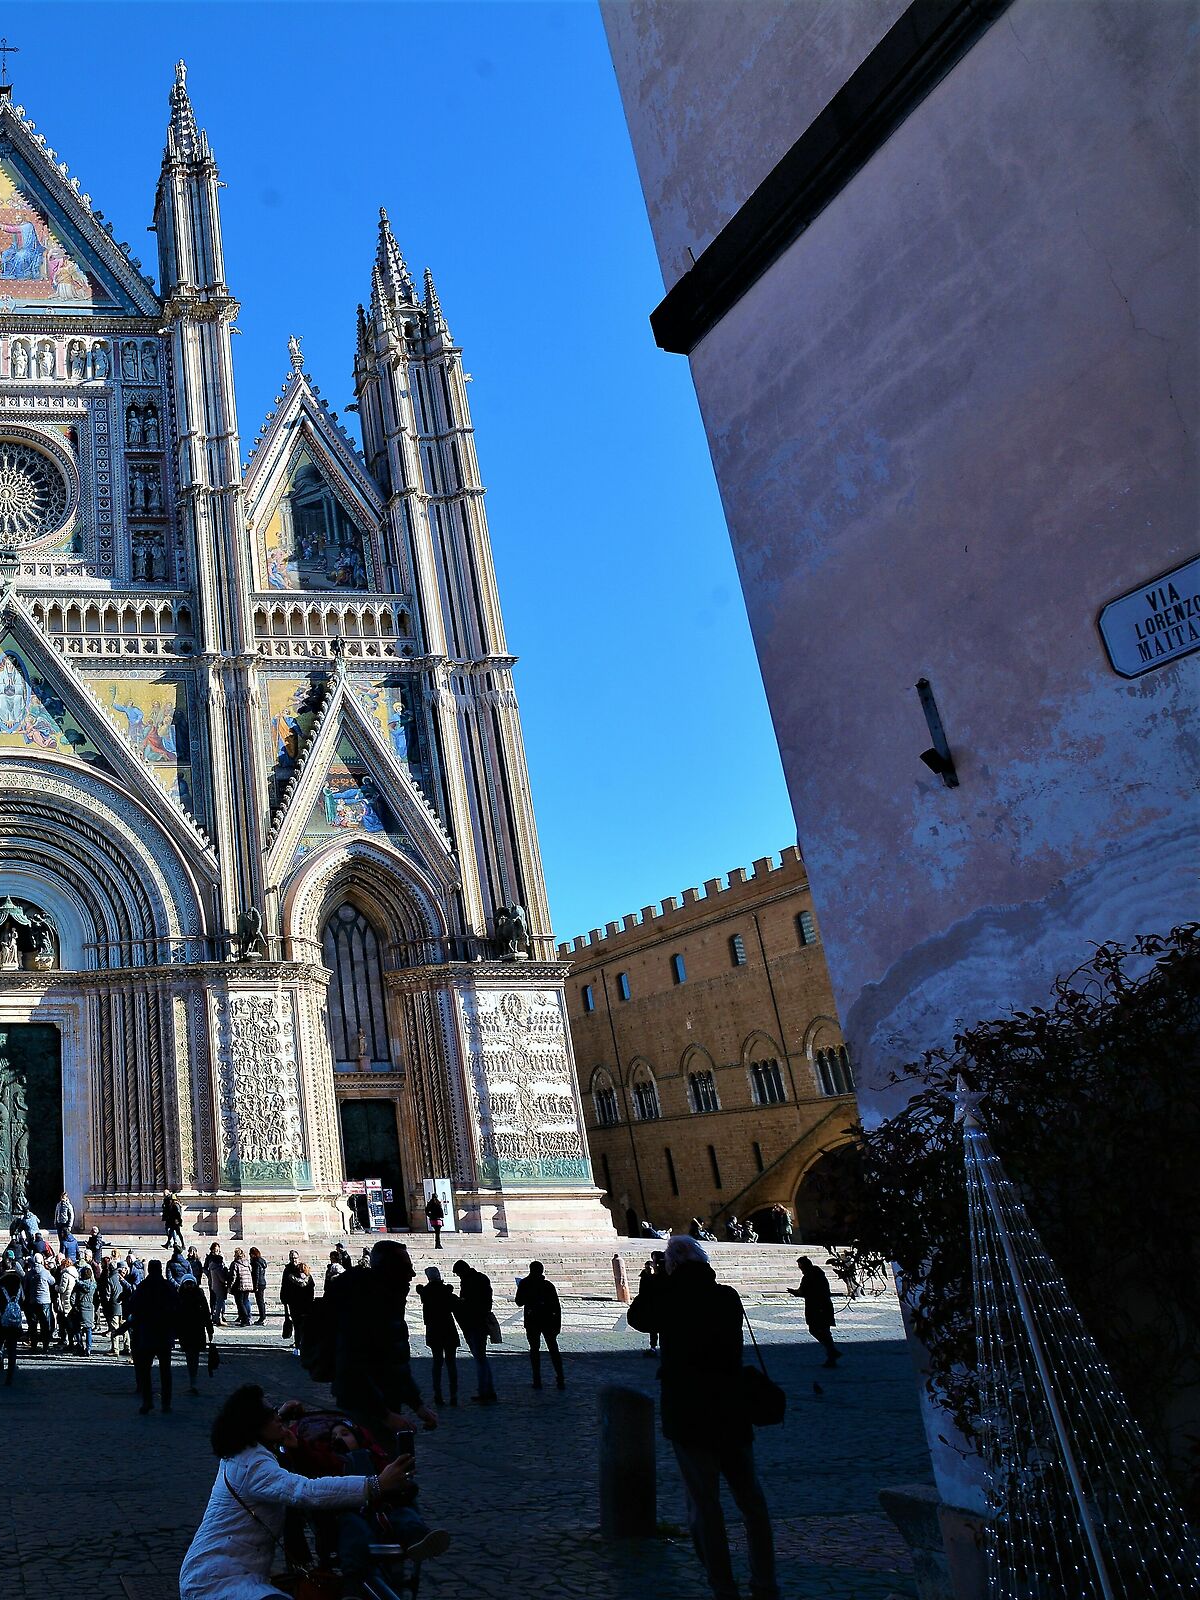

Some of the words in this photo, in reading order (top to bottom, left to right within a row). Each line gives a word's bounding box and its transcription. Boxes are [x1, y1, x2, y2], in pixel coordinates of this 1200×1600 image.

[1134, 594, 1200, 640] LORENZO
[1145, 582, 1180, 612] VIA
[1136, 615, 1200, 663] MAITA
